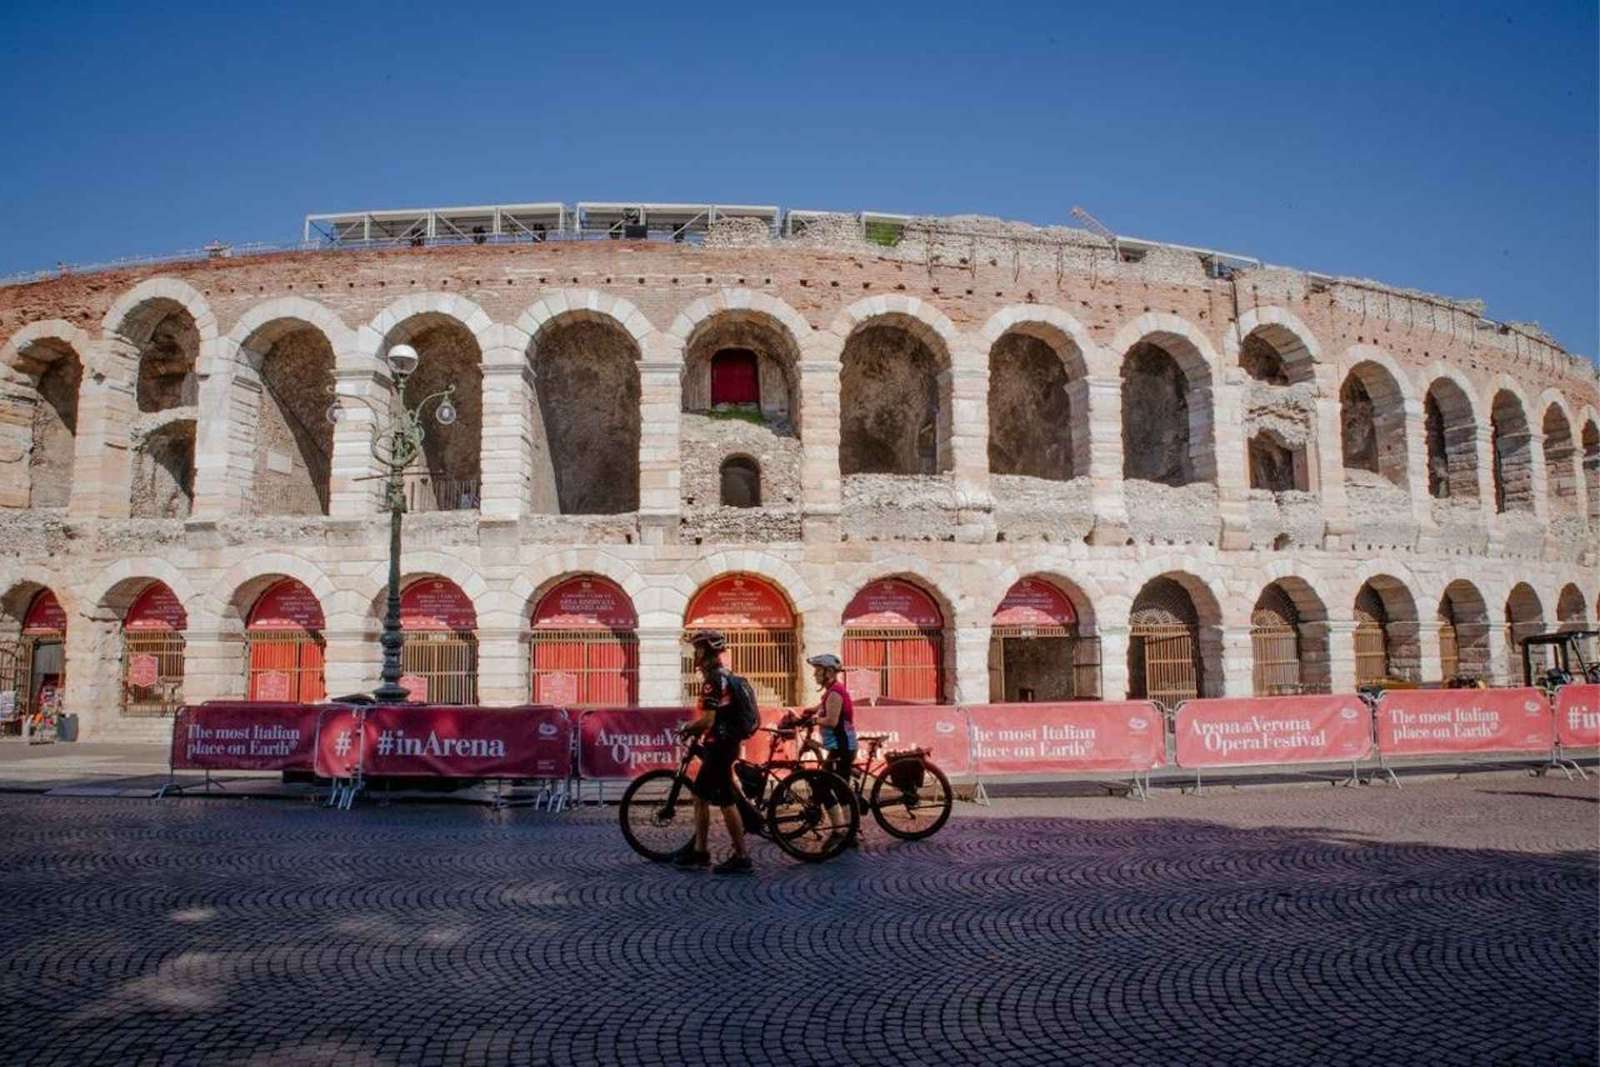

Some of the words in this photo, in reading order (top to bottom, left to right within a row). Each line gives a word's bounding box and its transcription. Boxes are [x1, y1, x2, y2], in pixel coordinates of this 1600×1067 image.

[1389, 709, 1416, 724] The
[1419, 711, 1451, 723] most
[1455, 708, 1499, 722] Italian
[187, 724, 213, 739] The
[216, 726, 250, 739] most
[254, 724, 300, 740] Italian
[999, 727, 1037, 741] most
[1042, 724, 1096, 740] Italian
[1192, 719, 1241, 736] Arena
[1251, 716, 1311, 732] Verona
[1393, 725, 1430, 744] place
[1432, 728, 1450, 741] on
[377, 729, 506, 757] #inArena
[595, 727, 650, 746] Arena
[1204, 731, 1259, 756] Opera
[1262, 730, 1326, 750] Festival
[187, 739, 225, 760] place
[228, 743, 246, 755] on
[611, 743, 673, 769] Opera
[1014, 746, 1035, 758] on
